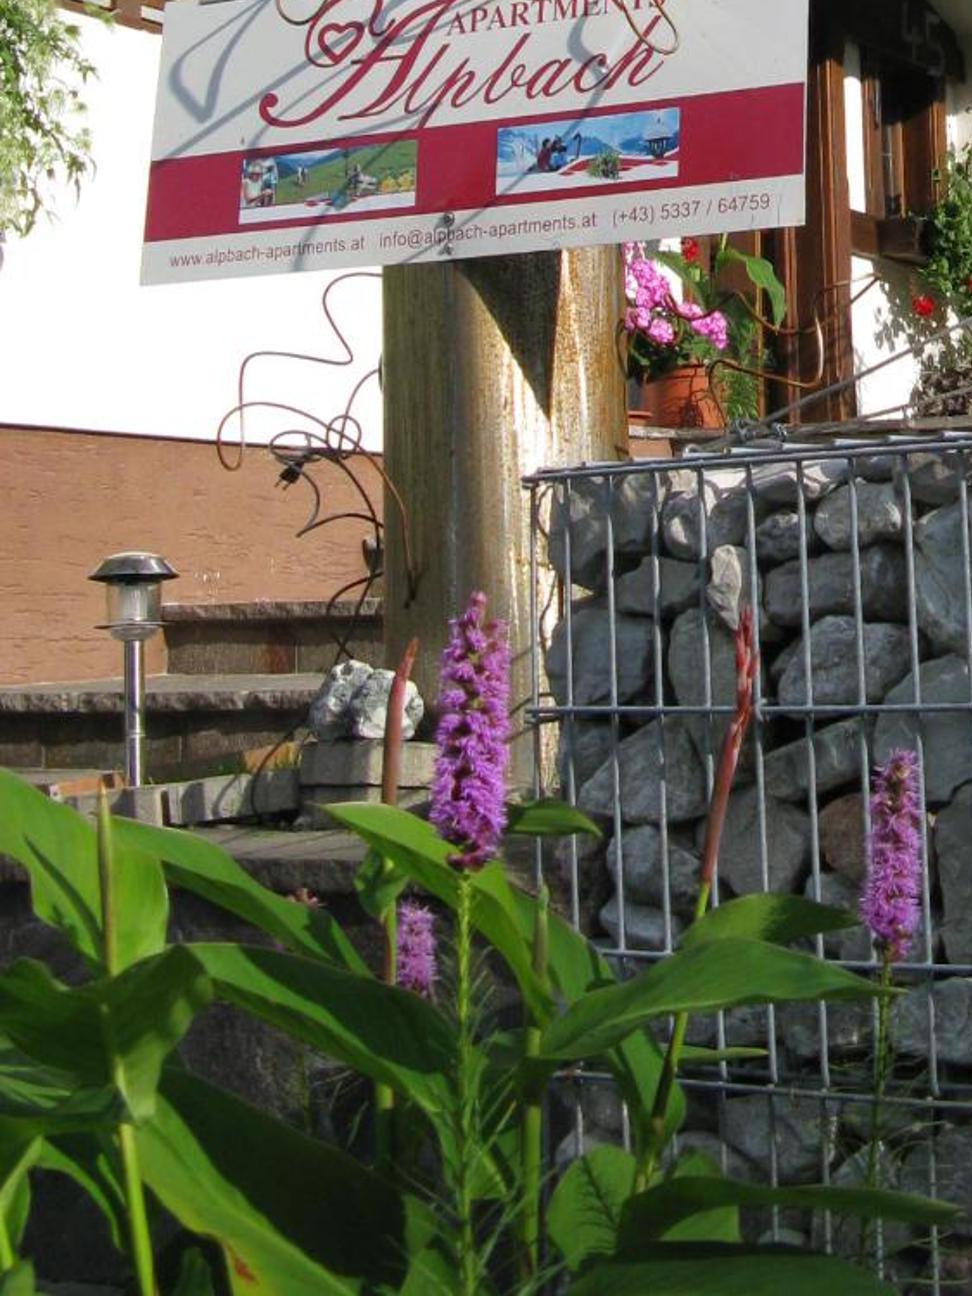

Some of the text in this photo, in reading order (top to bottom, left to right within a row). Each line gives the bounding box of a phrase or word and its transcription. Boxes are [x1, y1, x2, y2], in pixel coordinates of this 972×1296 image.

[170, 192, 770, 267] www.alpbach-apartments.at info@alpbach-apartments.at (+43) 5337 / 64759
